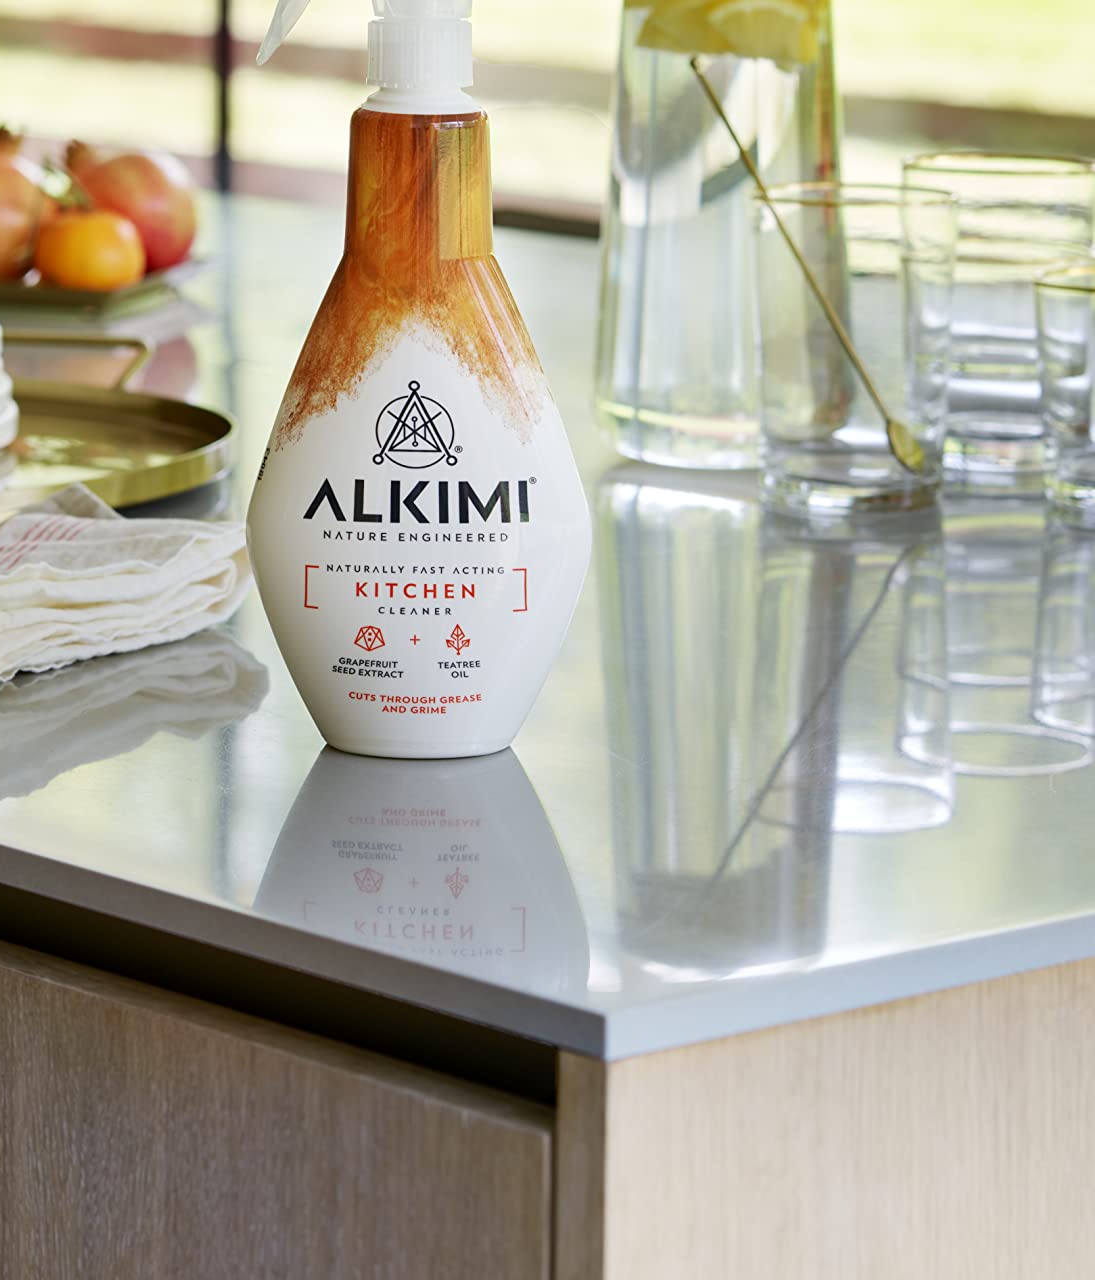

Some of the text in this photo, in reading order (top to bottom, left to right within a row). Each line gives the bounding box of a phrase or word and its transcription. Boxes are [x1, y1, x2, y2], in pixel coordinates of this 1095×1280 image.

[323, 529, 509, 543] NATURE ENGINEERED
[326, 563, 505, 575] NATURALLY FAST ACTING
[355, 581, 476, 600] KITCHEN
[377, 606, 452, 616] CLEANER
[338, 656, 399, 669] GRAPEFRUIT
[437, 660, 481, 670] TEATREE
[331, 665, 405, 679] SEED EXTRACT
[450, 670, 470, 679] OIL
[348, 691, 483, 705] CUTS THROUGH GREASE
[381, 705, 447, 715] AND GRIME
